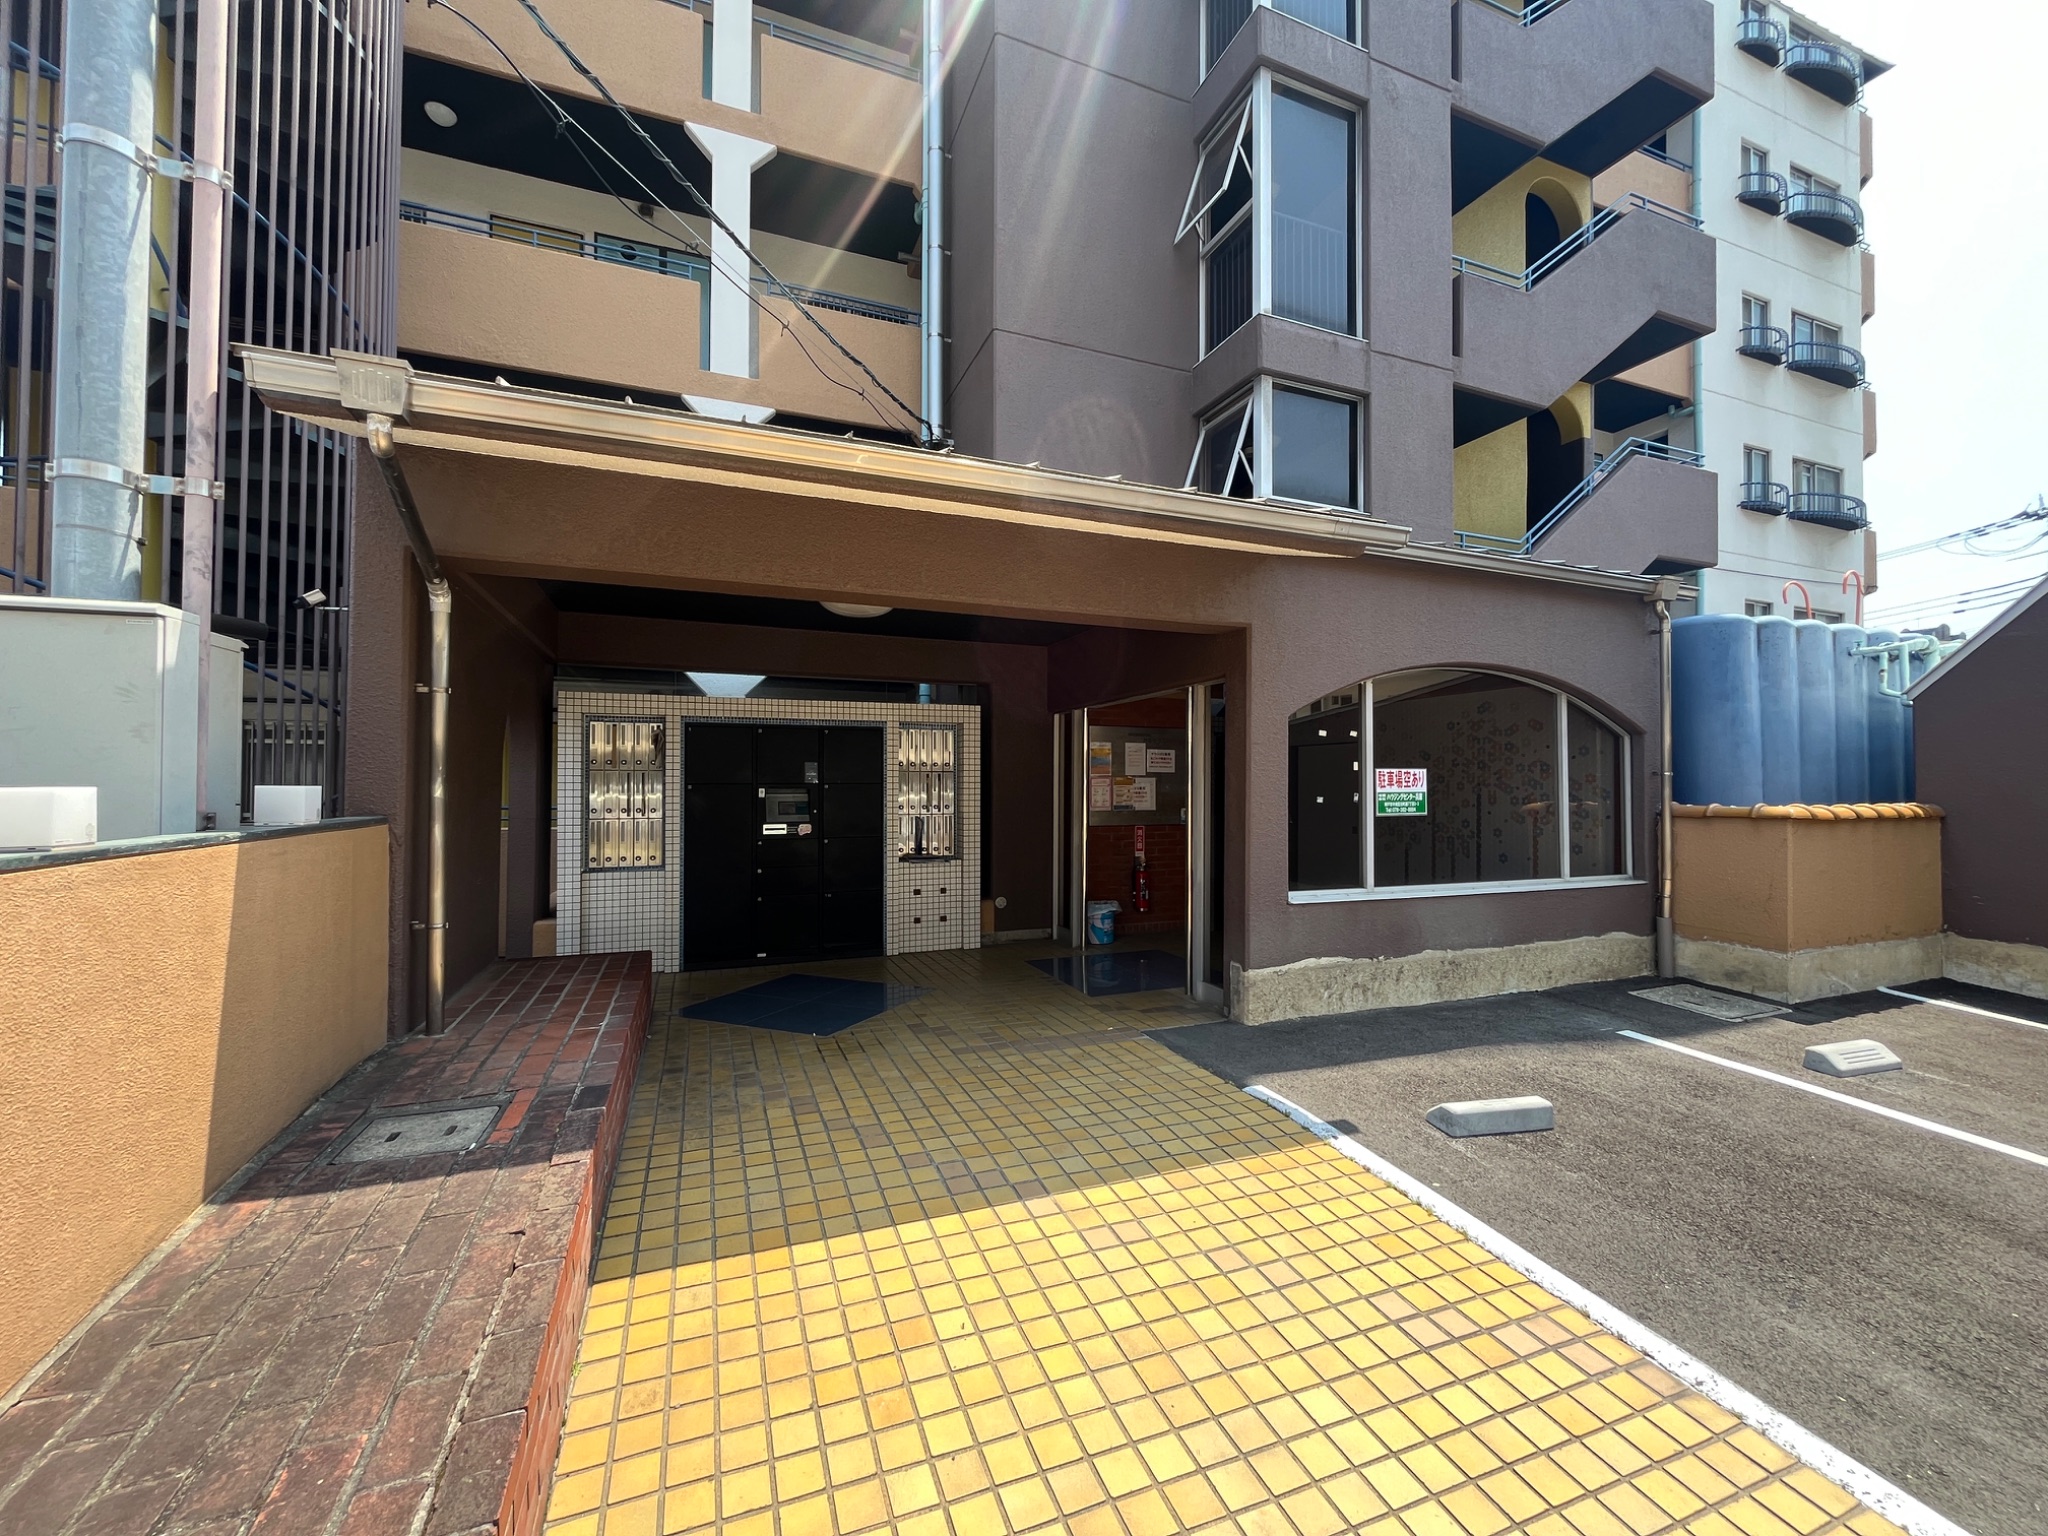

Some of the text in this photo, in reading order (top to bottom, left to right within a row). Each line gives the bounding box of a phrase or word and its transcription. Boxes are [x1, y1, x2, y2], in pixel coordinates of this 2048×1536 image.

[1378, 771, 1424, 788] 駐車場空あり
